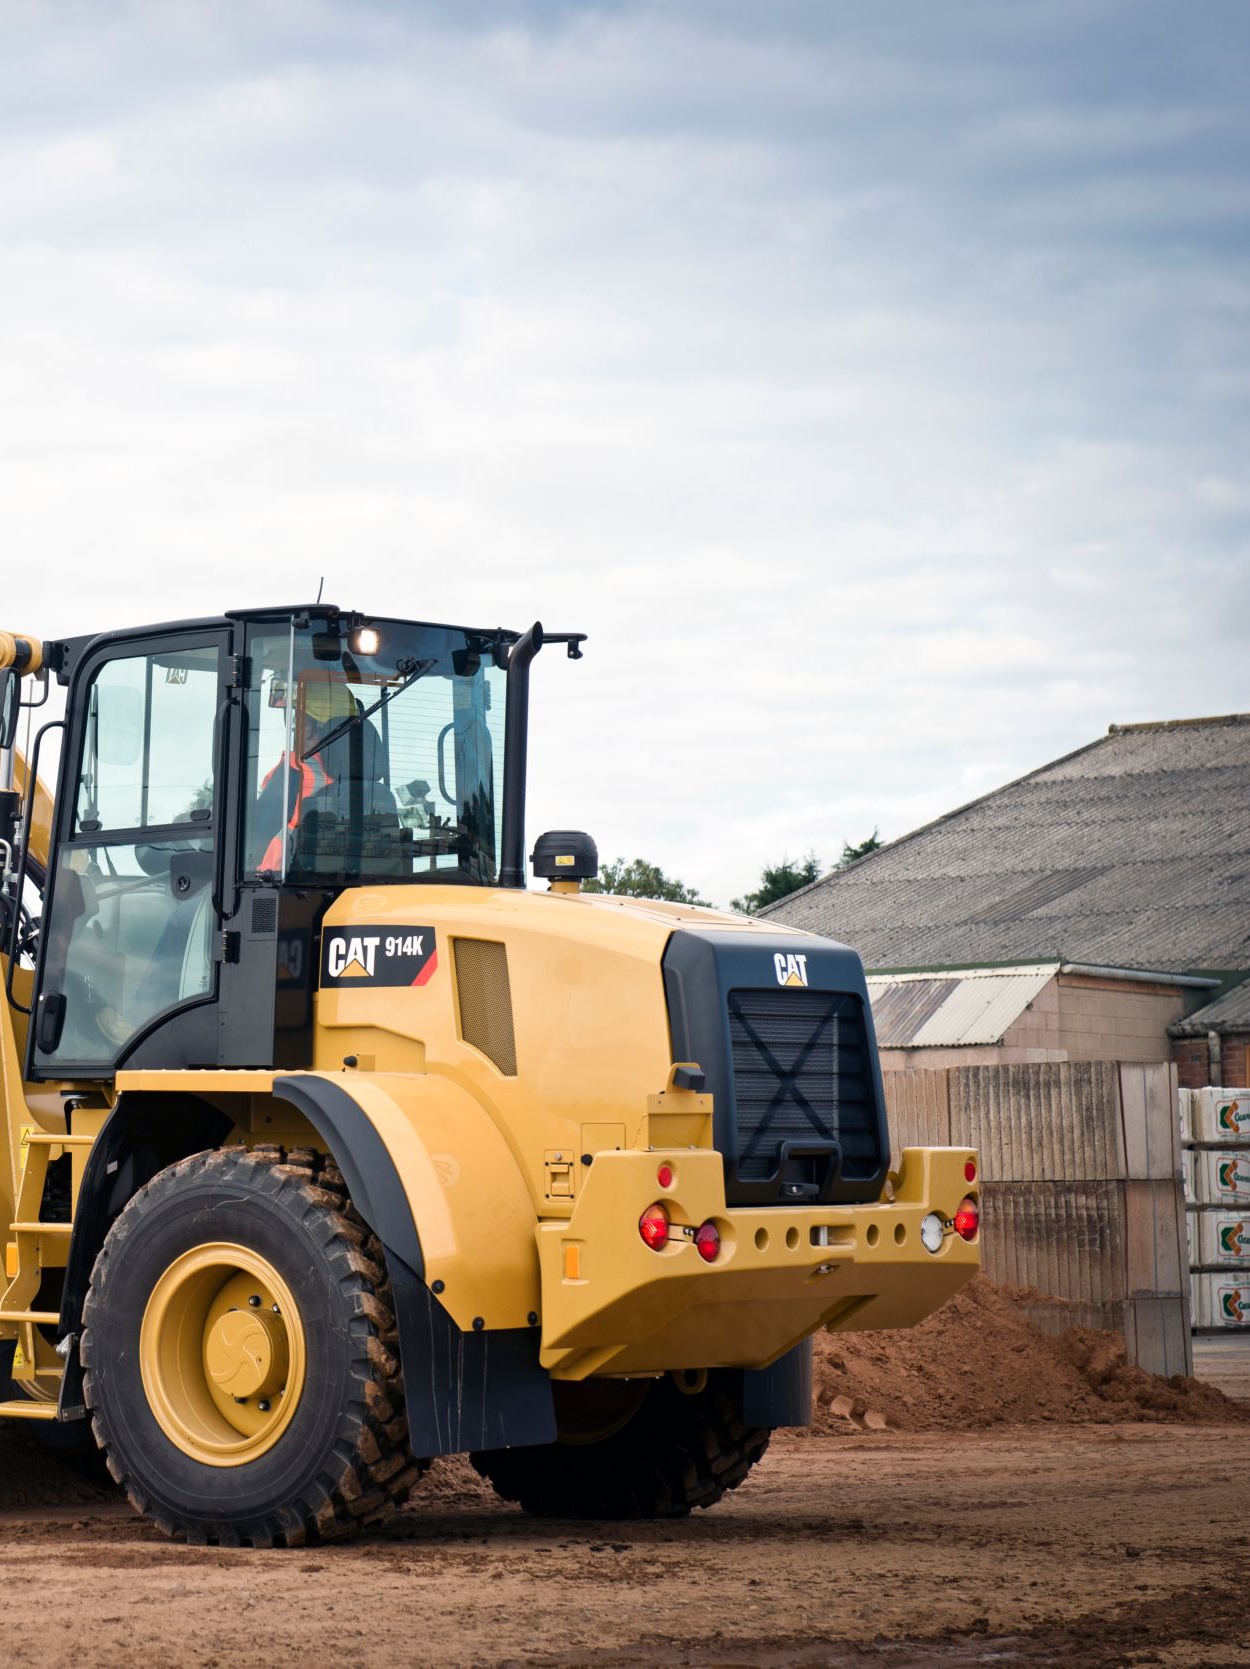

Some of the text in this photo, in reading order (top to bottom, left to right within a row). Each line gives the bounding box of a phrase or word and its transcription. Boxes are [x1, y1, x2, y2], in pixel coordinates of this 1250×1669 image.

[328, 935, 424, 978] CAT 914K
[773, 952, 809, 987] CAT
